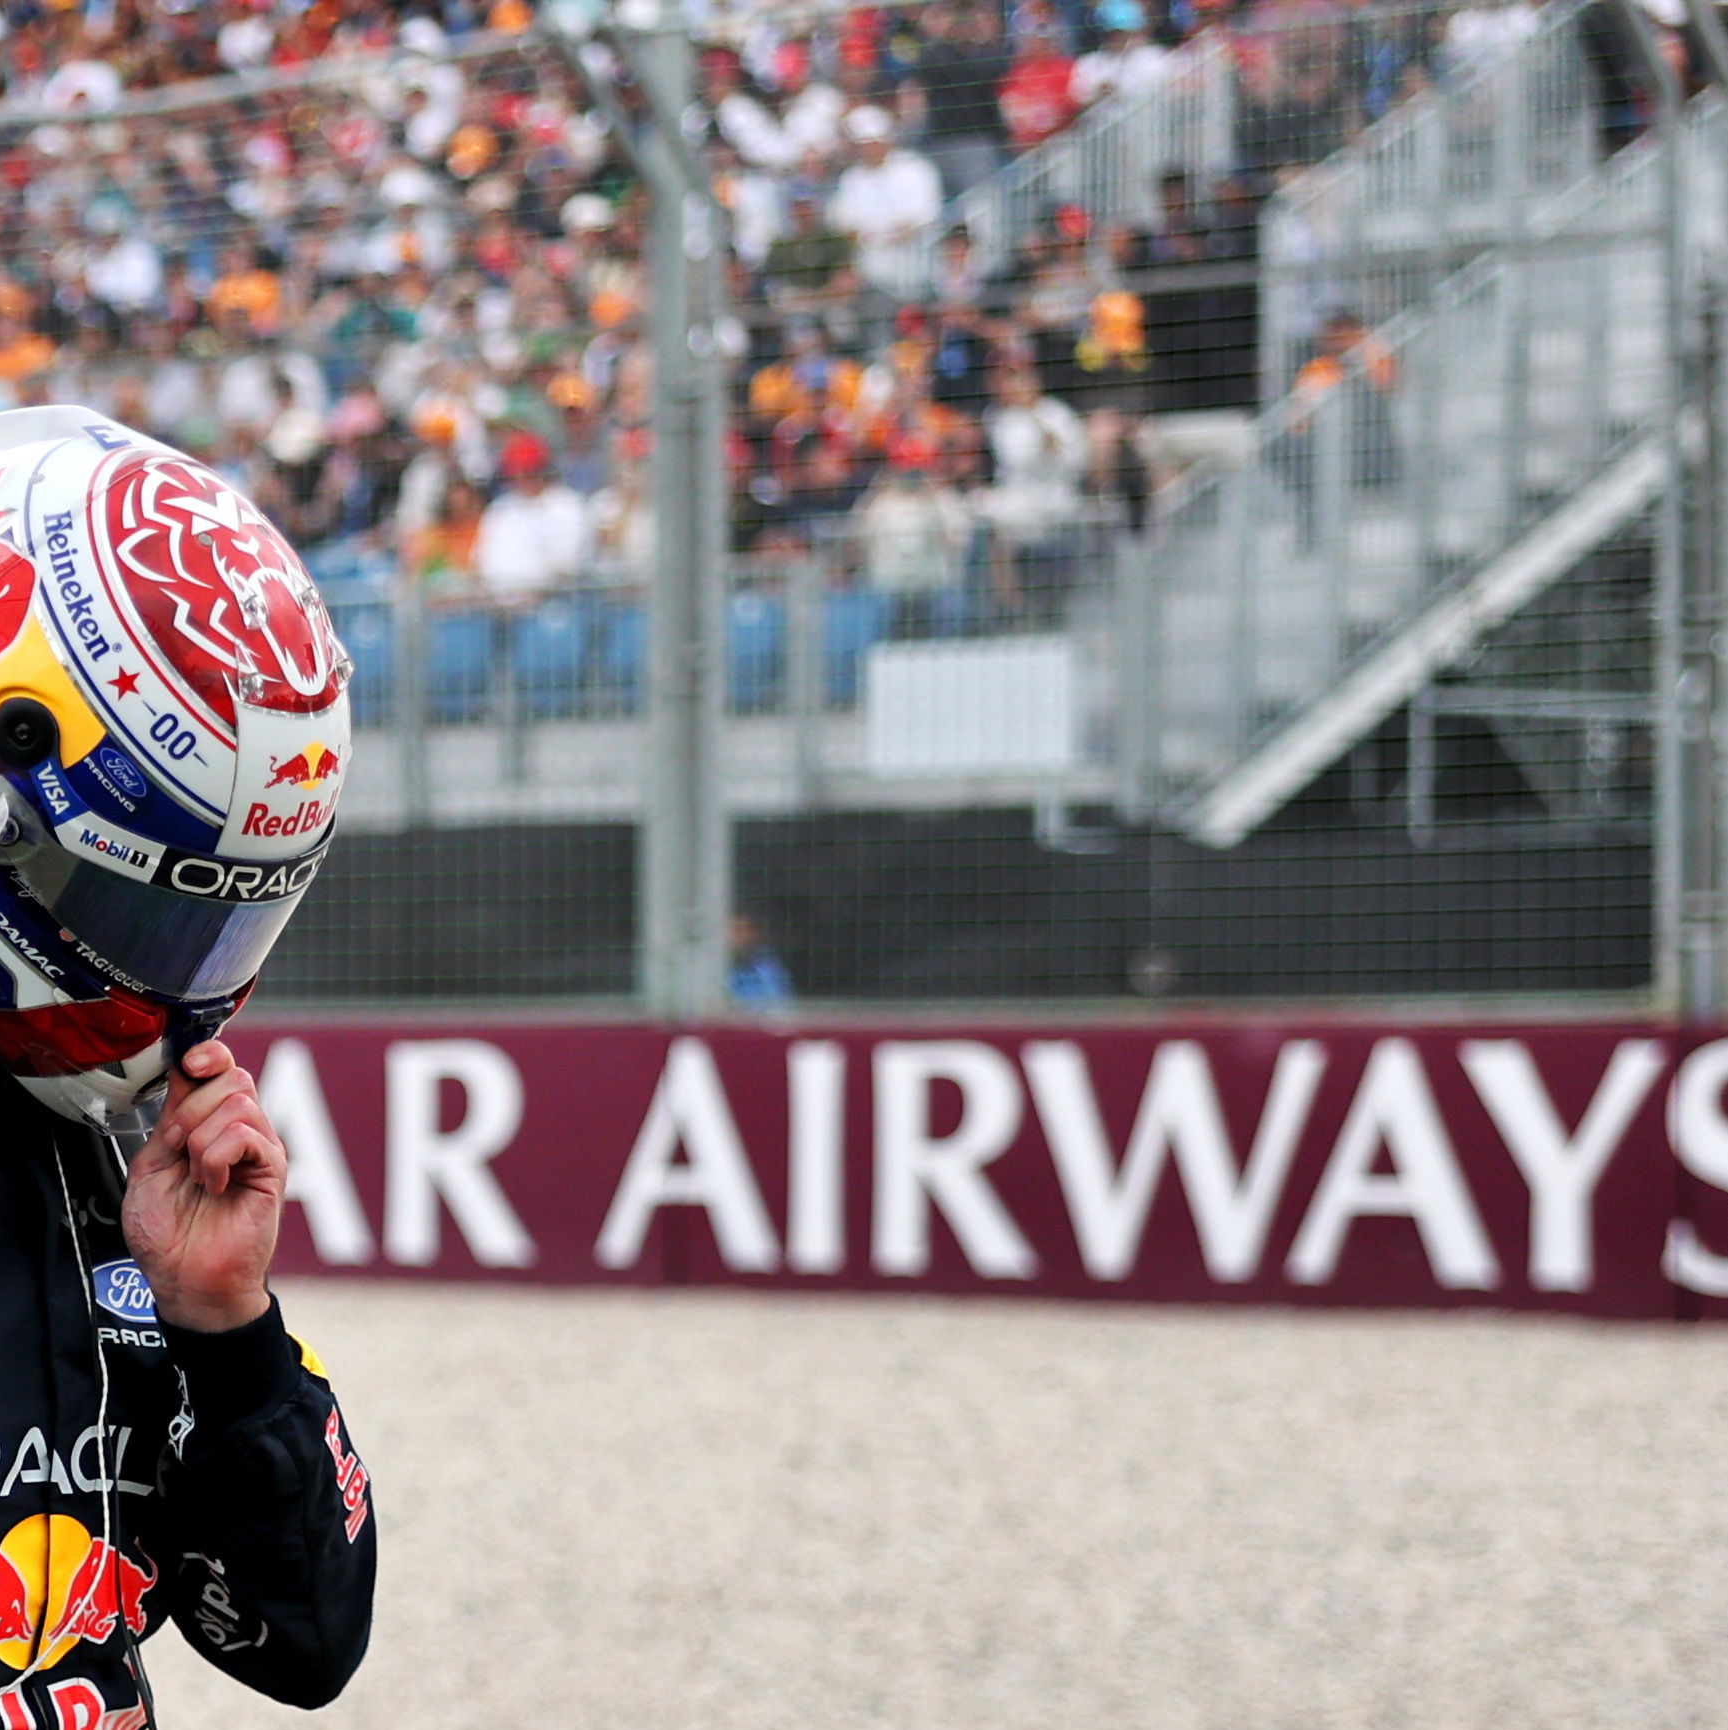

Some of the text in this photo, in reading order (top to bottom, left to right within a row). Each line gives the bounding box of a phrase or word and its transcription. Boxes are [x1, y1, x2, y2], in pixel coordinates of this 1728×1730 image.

[43, 510, 111, 662] Heineken
[37, 761, 70, 816] VISA
[83, 757, 136, 813] RACING
[106, 757, 139, 790] Ford
[241, 802, 306, 838] Red
[79, 828, 131, 861] Mobil
[171, 853, 322, 899] ORAC
[107, 1266, 157, 1310] For
